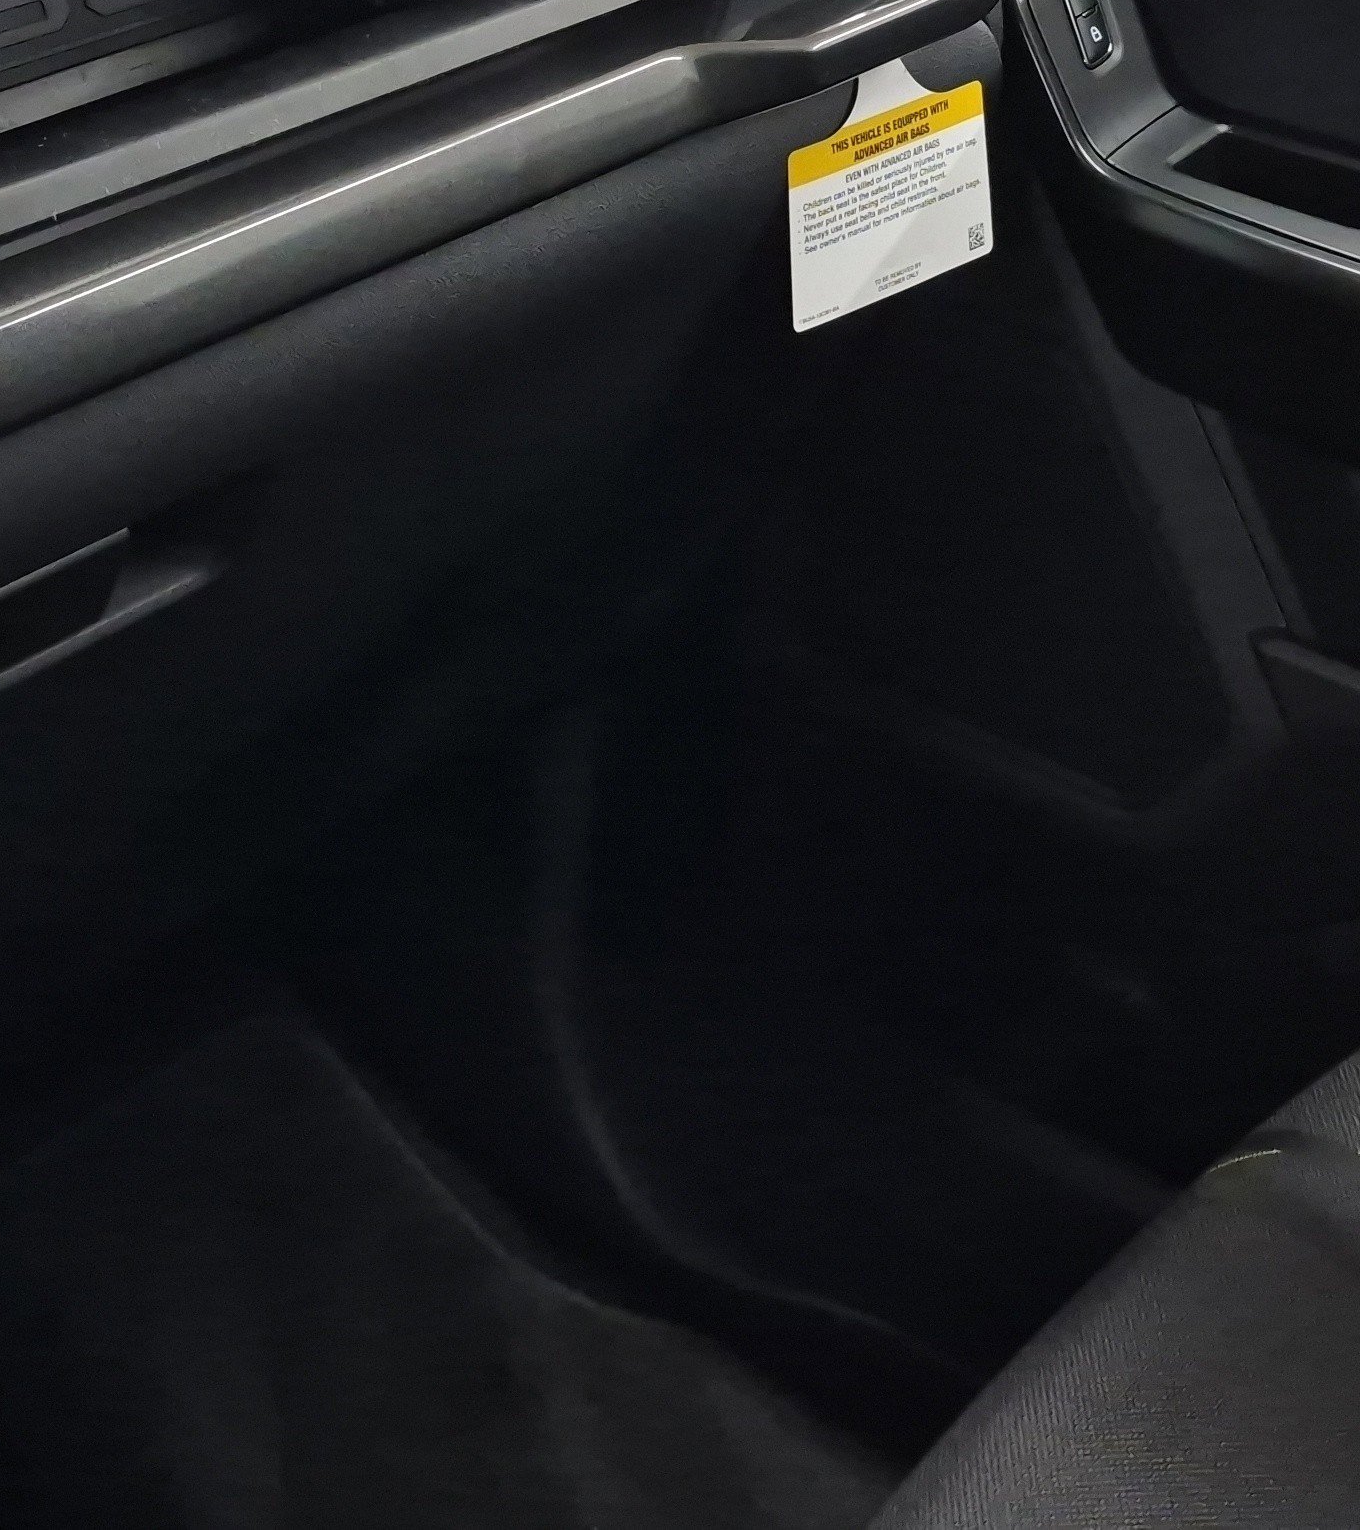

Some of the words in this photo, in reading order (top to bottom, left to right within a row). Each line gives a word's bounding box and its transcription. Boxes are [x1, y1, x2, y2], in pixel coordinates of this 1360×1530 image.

[831, 139, 849, 154] THIS
[850, 125, 882, 146] VEHICLE
[883, 122, 891, 134] IS
[893, 108, 928, 130] EQUIPPED
[929, 99, 949, 116] WITH
[854, 138, 894, 162] ADVANCED
[896, 132, 909, 145] AIR
[910, 123, 930, 139] BAGS
[803, 196, 832, 211] Children
[834, 191, 846, 200] can
[847, 186, 855, 195] be
[857, 179, 874, 191] killed
[884, 164, 912, 180] seriously
[914, 154, 935, 168] injured
[936, 151, 944, 160] by
[946, 146, 955, 155] the
[845, 170, 862, 183] EVEN
[863, 162, 880, 176] WITH
[881, 150, 911, 170] ADVANCED
[913, 146, 924, 157] AIR
[925, 139, 940, 151] BAGS
[803, 213, 816, 222] The
[818, 205, 834, 217] back
[836, 199, 849, 210] seat
[851, 196, 858, 204] is
[859, 192, 869, 201] the
[871, 184, 890, 196] safest
[892, 177, 908, 190] place
[910, 171, 918, 180] for
[920, 161, 947, 176] Children.
[804, 220, 823, 233] Never
[826, 215, 837, 226] put
[844, 208, 857, 218] rear
[859, 198, 879, 212] facing
[880, 192, 895, 203] child
[897, 186, 910, 197] seat
[919, 178, 929, 187] the
[805, 244, 818, 254] See
[820, 235, 846, 249] owner's
[848, 223, 871, 238] manual
[873, 219, 881, 227] for
[883, 212, 899, 223] more
[901, 197, 937, 216] information
[938, 189, 955, 201] about
[956, 185, 964, 193] air
[805, 230, 829, 244] Always
[831, 224, 843, 233] use
[845, 217, 859, 228] seat
[860, 211, 875, 222] belts
[877, 205, 890, 215] and
[891, 198, 906, 209] child
